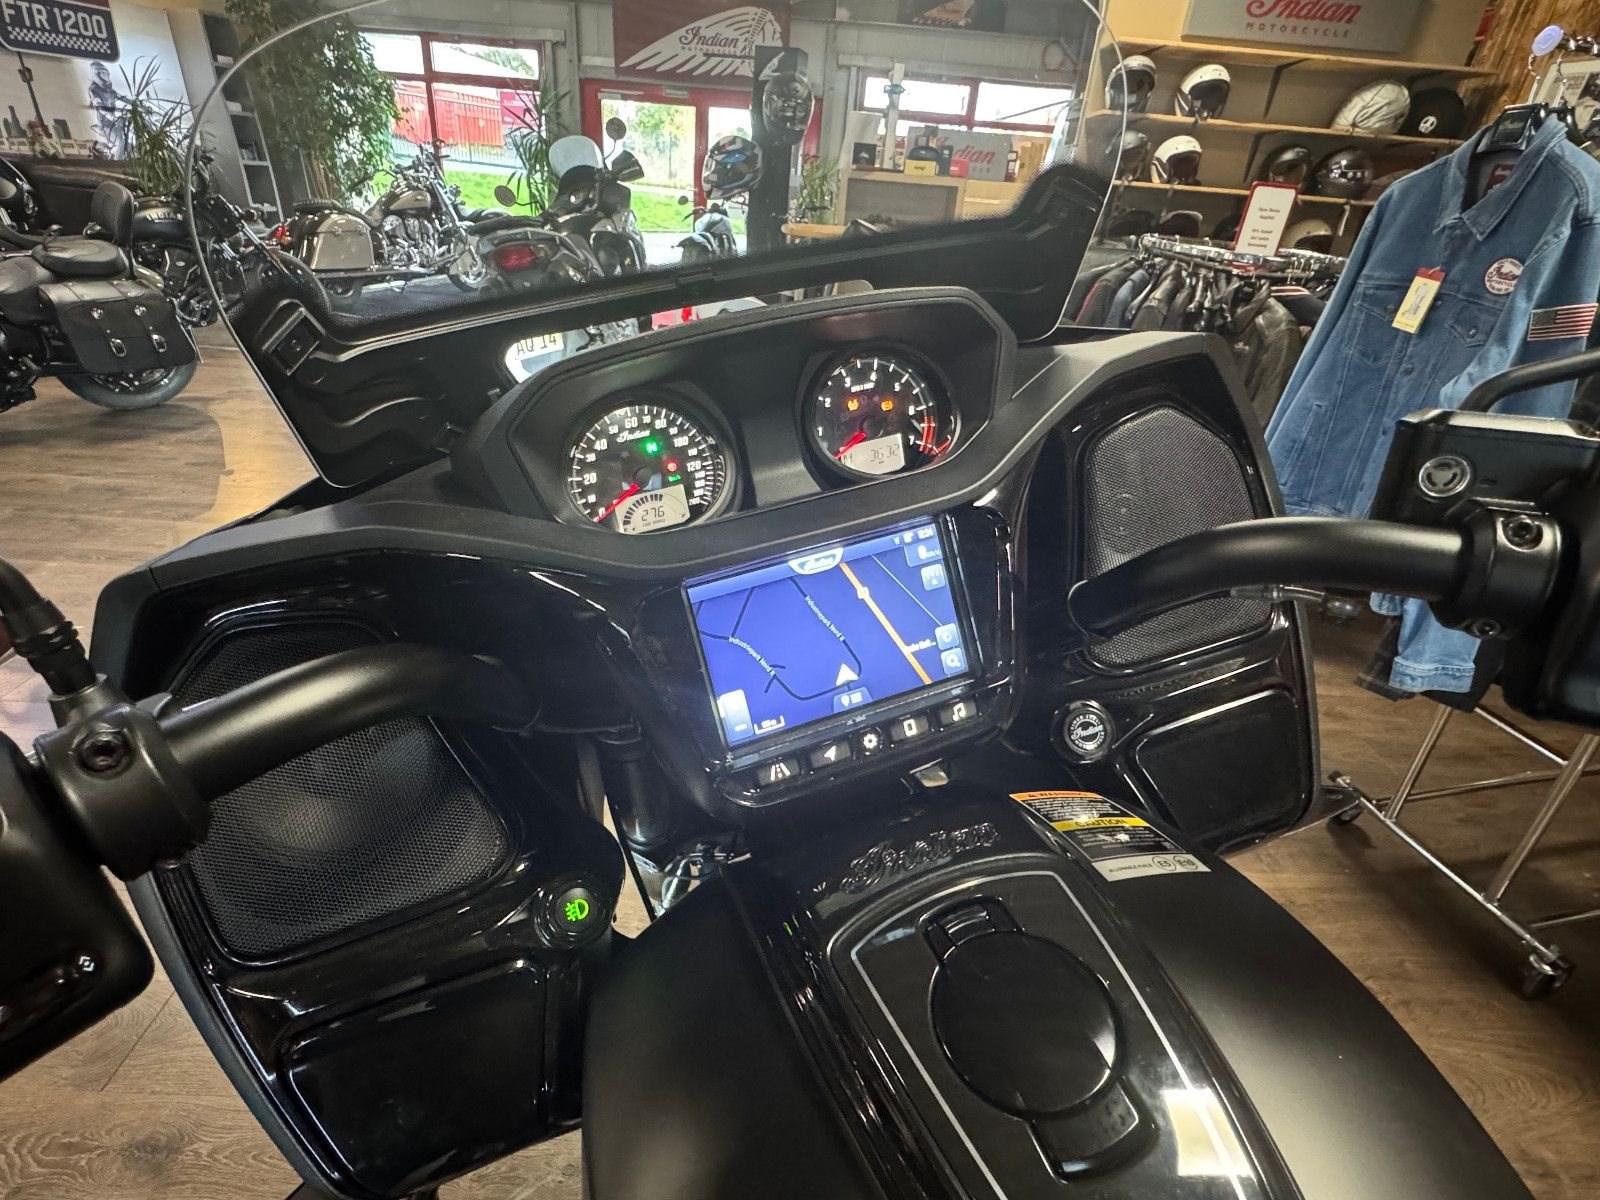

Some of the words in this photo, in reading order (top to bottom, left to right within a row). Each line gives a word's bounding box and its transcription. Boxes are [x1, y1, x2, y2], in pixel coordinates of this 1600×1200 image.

[1246, 0, 1362, 24] Indian
[1, 0, 51, 30] FTR
[53, 7, 108, 39] 1200
[1246, 21, 1350, 39] MOTORCYCLE
[679, 26, 740, 49] Indian
[844, 377, 851, 388] 3
[894, 382, 901, 392] 5
[825, 397, 832, 408] 2
[624, 417, 639, 429] 60
[655, 418, 668, 430] 80
[608, 425, 619, 435] 50
[616, 429, 651, 443] Indian
[594, 438, 608, 451] 40
[673, 435, 689, 448] 100
[908, 435, 915, 446] 7
[585, 452, 597, 463] 30
[686, 460, 702, 473] 120
[583, 472, 597, 486] 20
[641, 505, 665, 522] 276
[1070, 724, 1105, 740] Indian
[1074, 818, 1127, 828] CAUTION
[1157, 860, 1172, 868] E5
